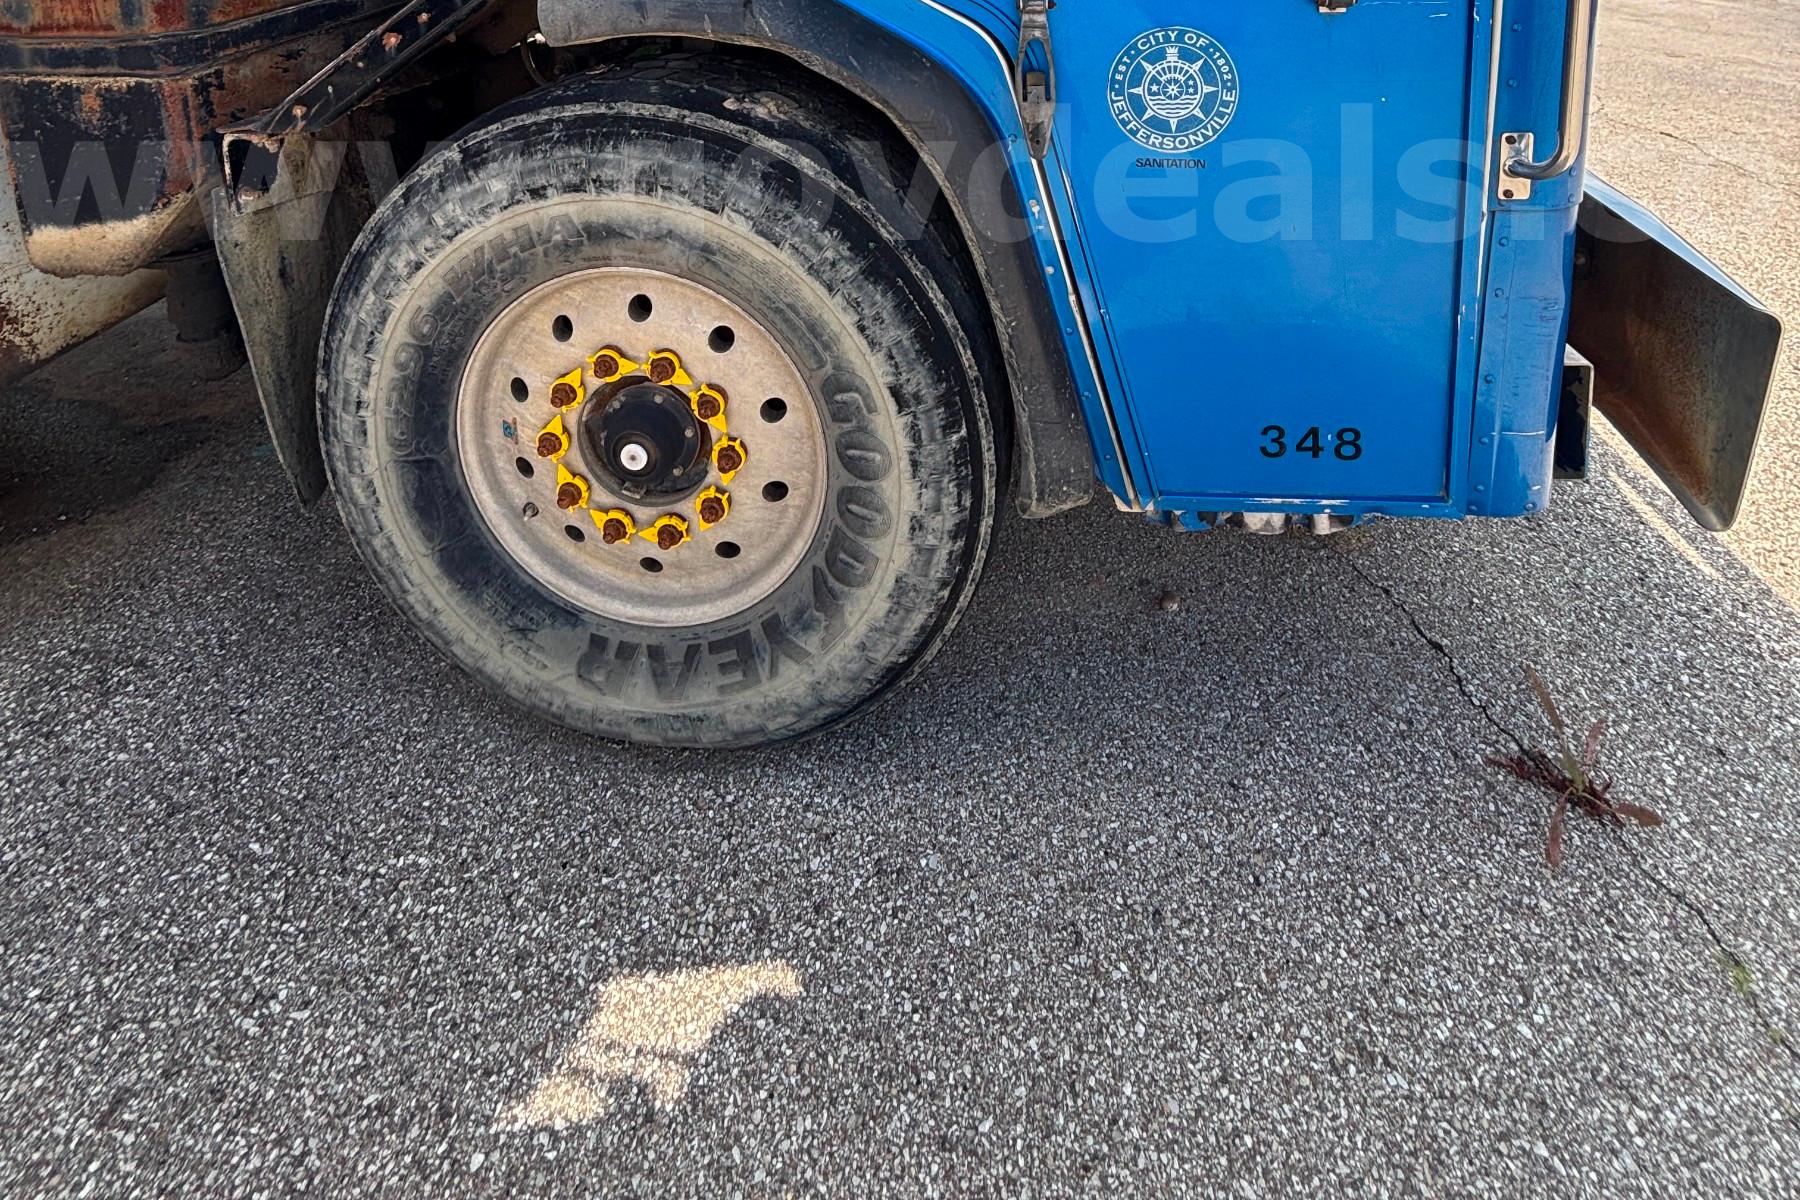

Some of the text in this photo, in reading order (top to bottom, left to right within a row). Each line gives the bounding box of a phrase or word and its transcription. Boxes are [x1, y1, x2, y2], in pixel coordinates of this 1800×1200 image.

[1137, 30, 1210, 50] CITY OF
[1115, 51, 1232, 81] EST 1802
[1111, 89, 1236, 150] JEFFERSONVILLE
[1135, 158, 1206, 169] SANITATION
[1259, 424, 1363, 461] 348
[576, 370, 893, 700] GOODYEAR
